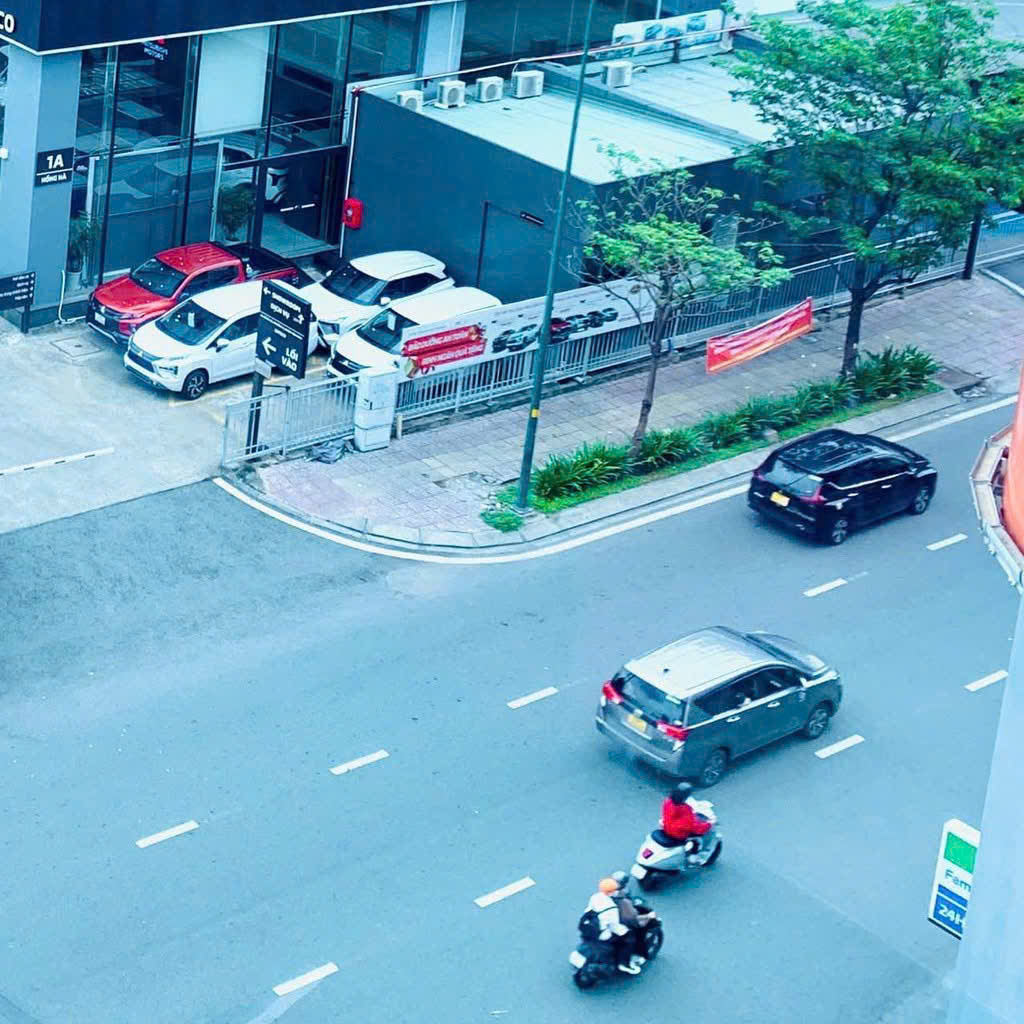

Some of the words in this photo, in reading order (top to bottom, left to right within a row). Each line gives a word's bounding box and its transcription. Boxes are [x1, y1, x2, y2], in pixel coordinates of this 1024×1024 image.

[46, 153, 64, 169] 1A
[285, 347, 298, 362] LỐI
[281, 356, 297, 371] VÀO
